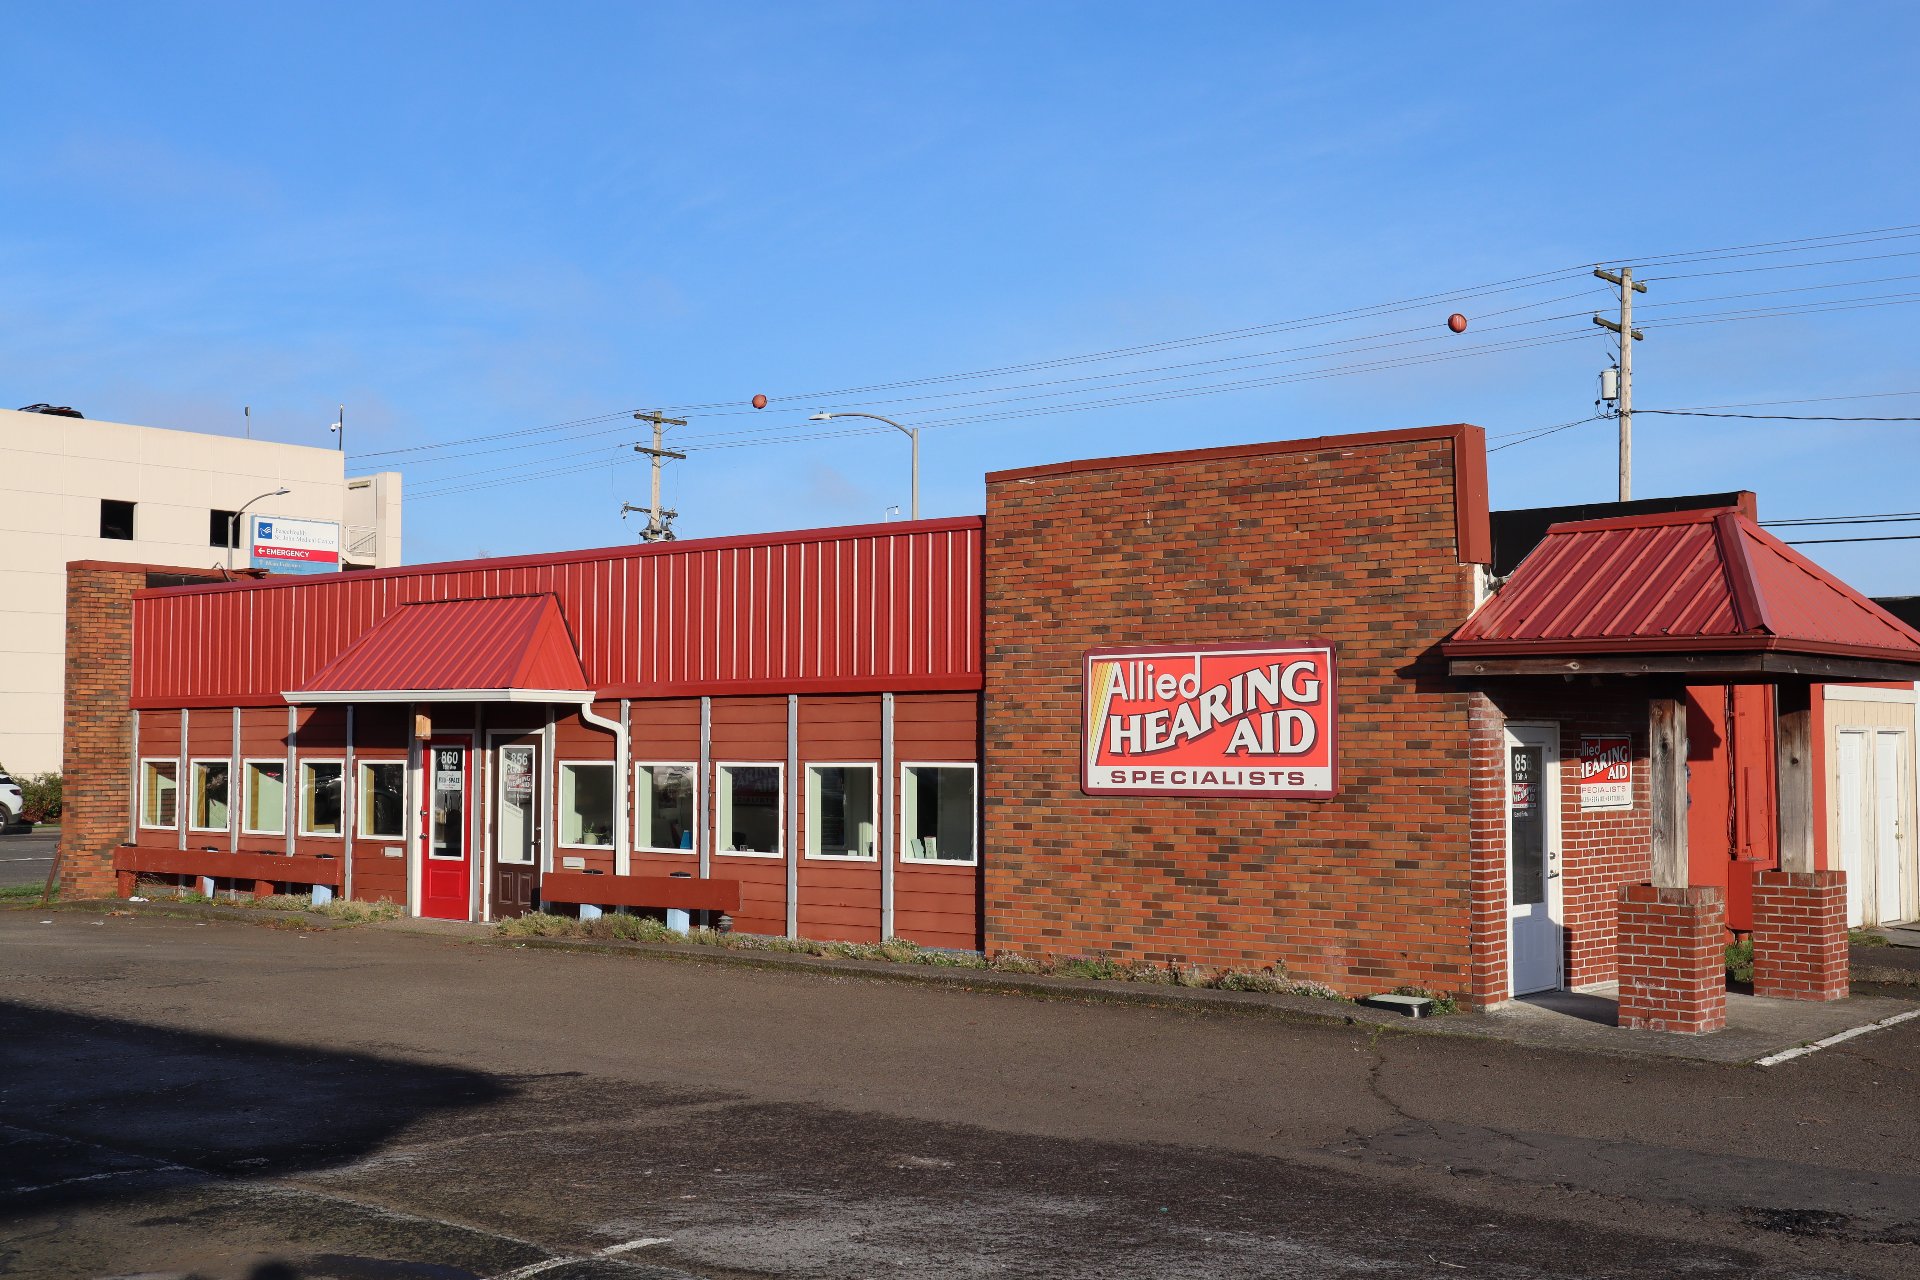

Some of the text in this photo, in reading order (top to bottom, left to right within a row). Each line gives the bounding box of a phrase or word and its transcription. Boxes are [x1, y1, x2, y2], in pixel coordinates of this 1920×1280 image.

[266, 548, 310, 557] EMERGENCY
[1109, 654, 1201, 701] Allied
[1108, 660, 1321, 756] HEARING
[1223, 708, 1318, 756] AID
[1581, 739, 1600, 756] llied
[441, 751, 459, 764] 860
[511, 752, 528, 766] 856
[1110, 770, 1305, 786] SPECIALISTS
[1607, 764, 1628, 780] AID
[1582, 785, 1626, 794] PECIALISTS
